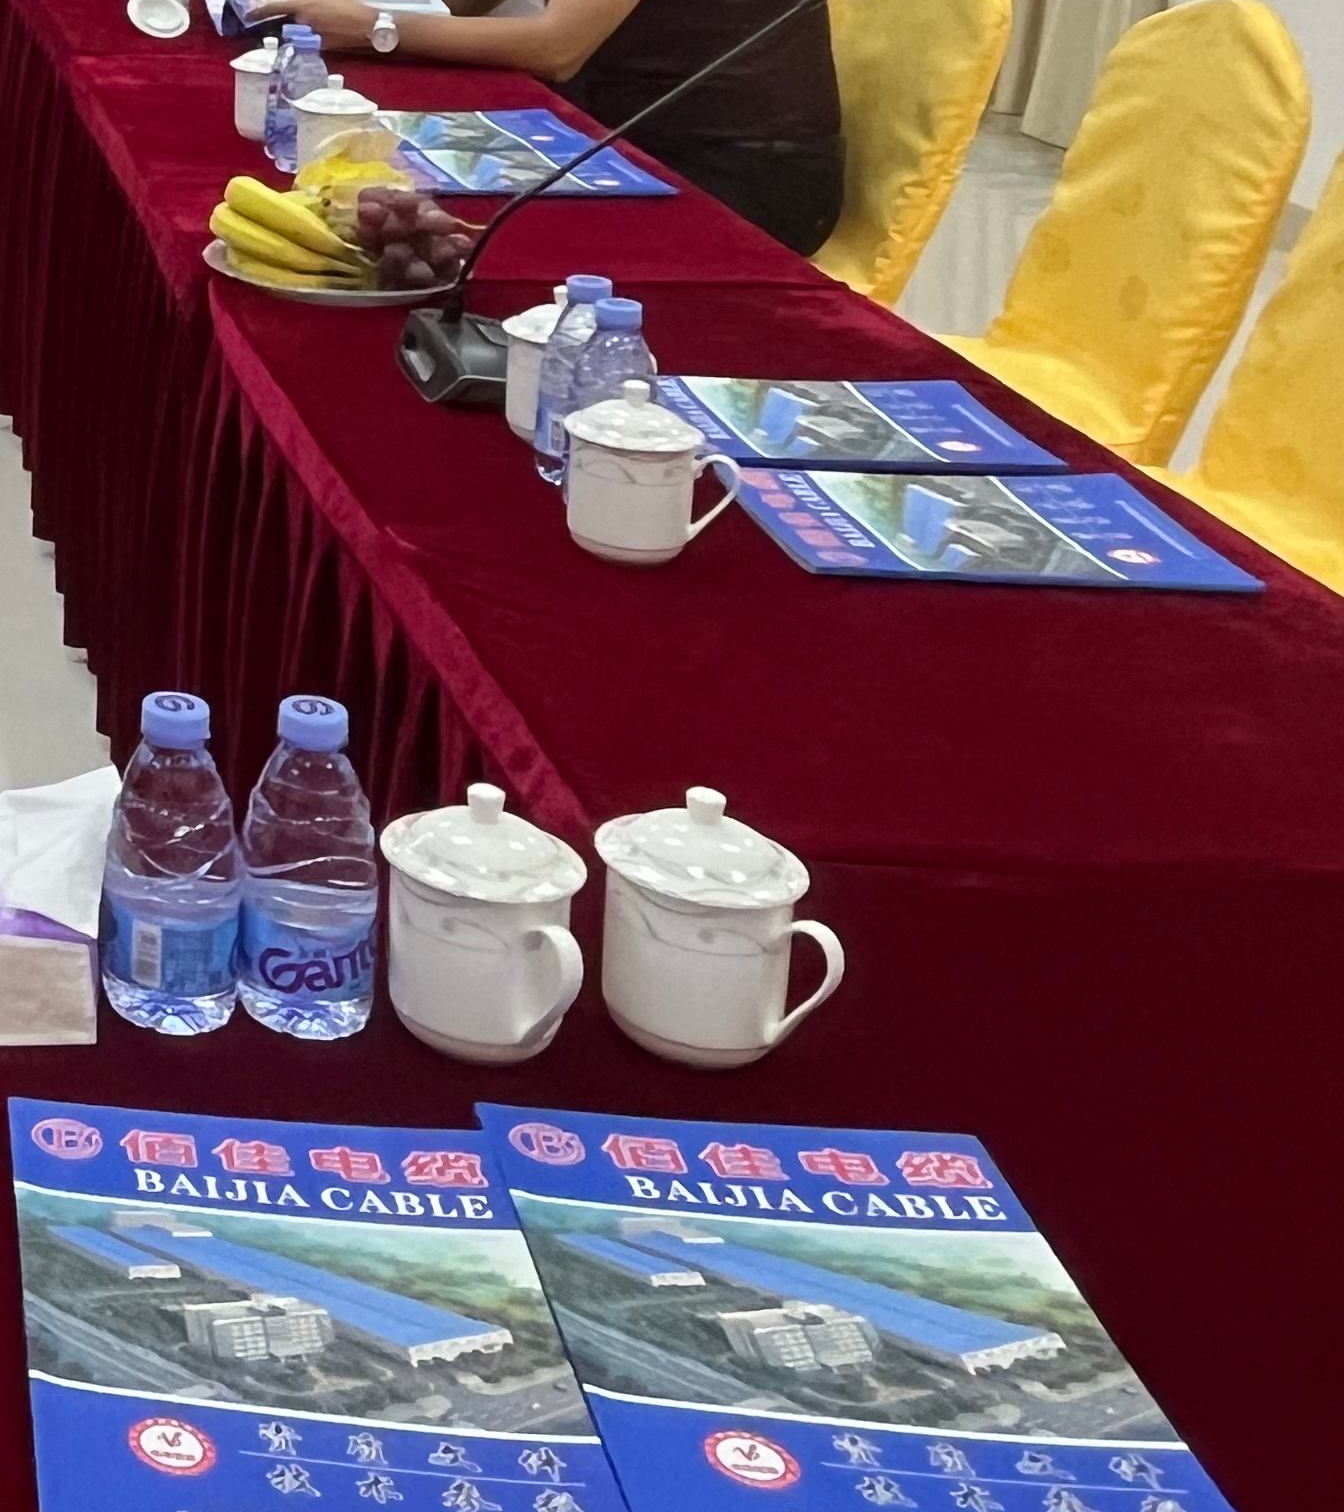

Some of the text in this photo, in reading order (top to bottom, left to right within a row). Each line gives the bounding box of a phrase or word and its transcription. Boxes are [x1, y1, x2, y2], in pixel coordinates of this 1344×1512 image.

[134, 1168, 494, 1220] BAIJIA CABLE
[624, 1175, 1008, 1221] BAIJIA CABLE
